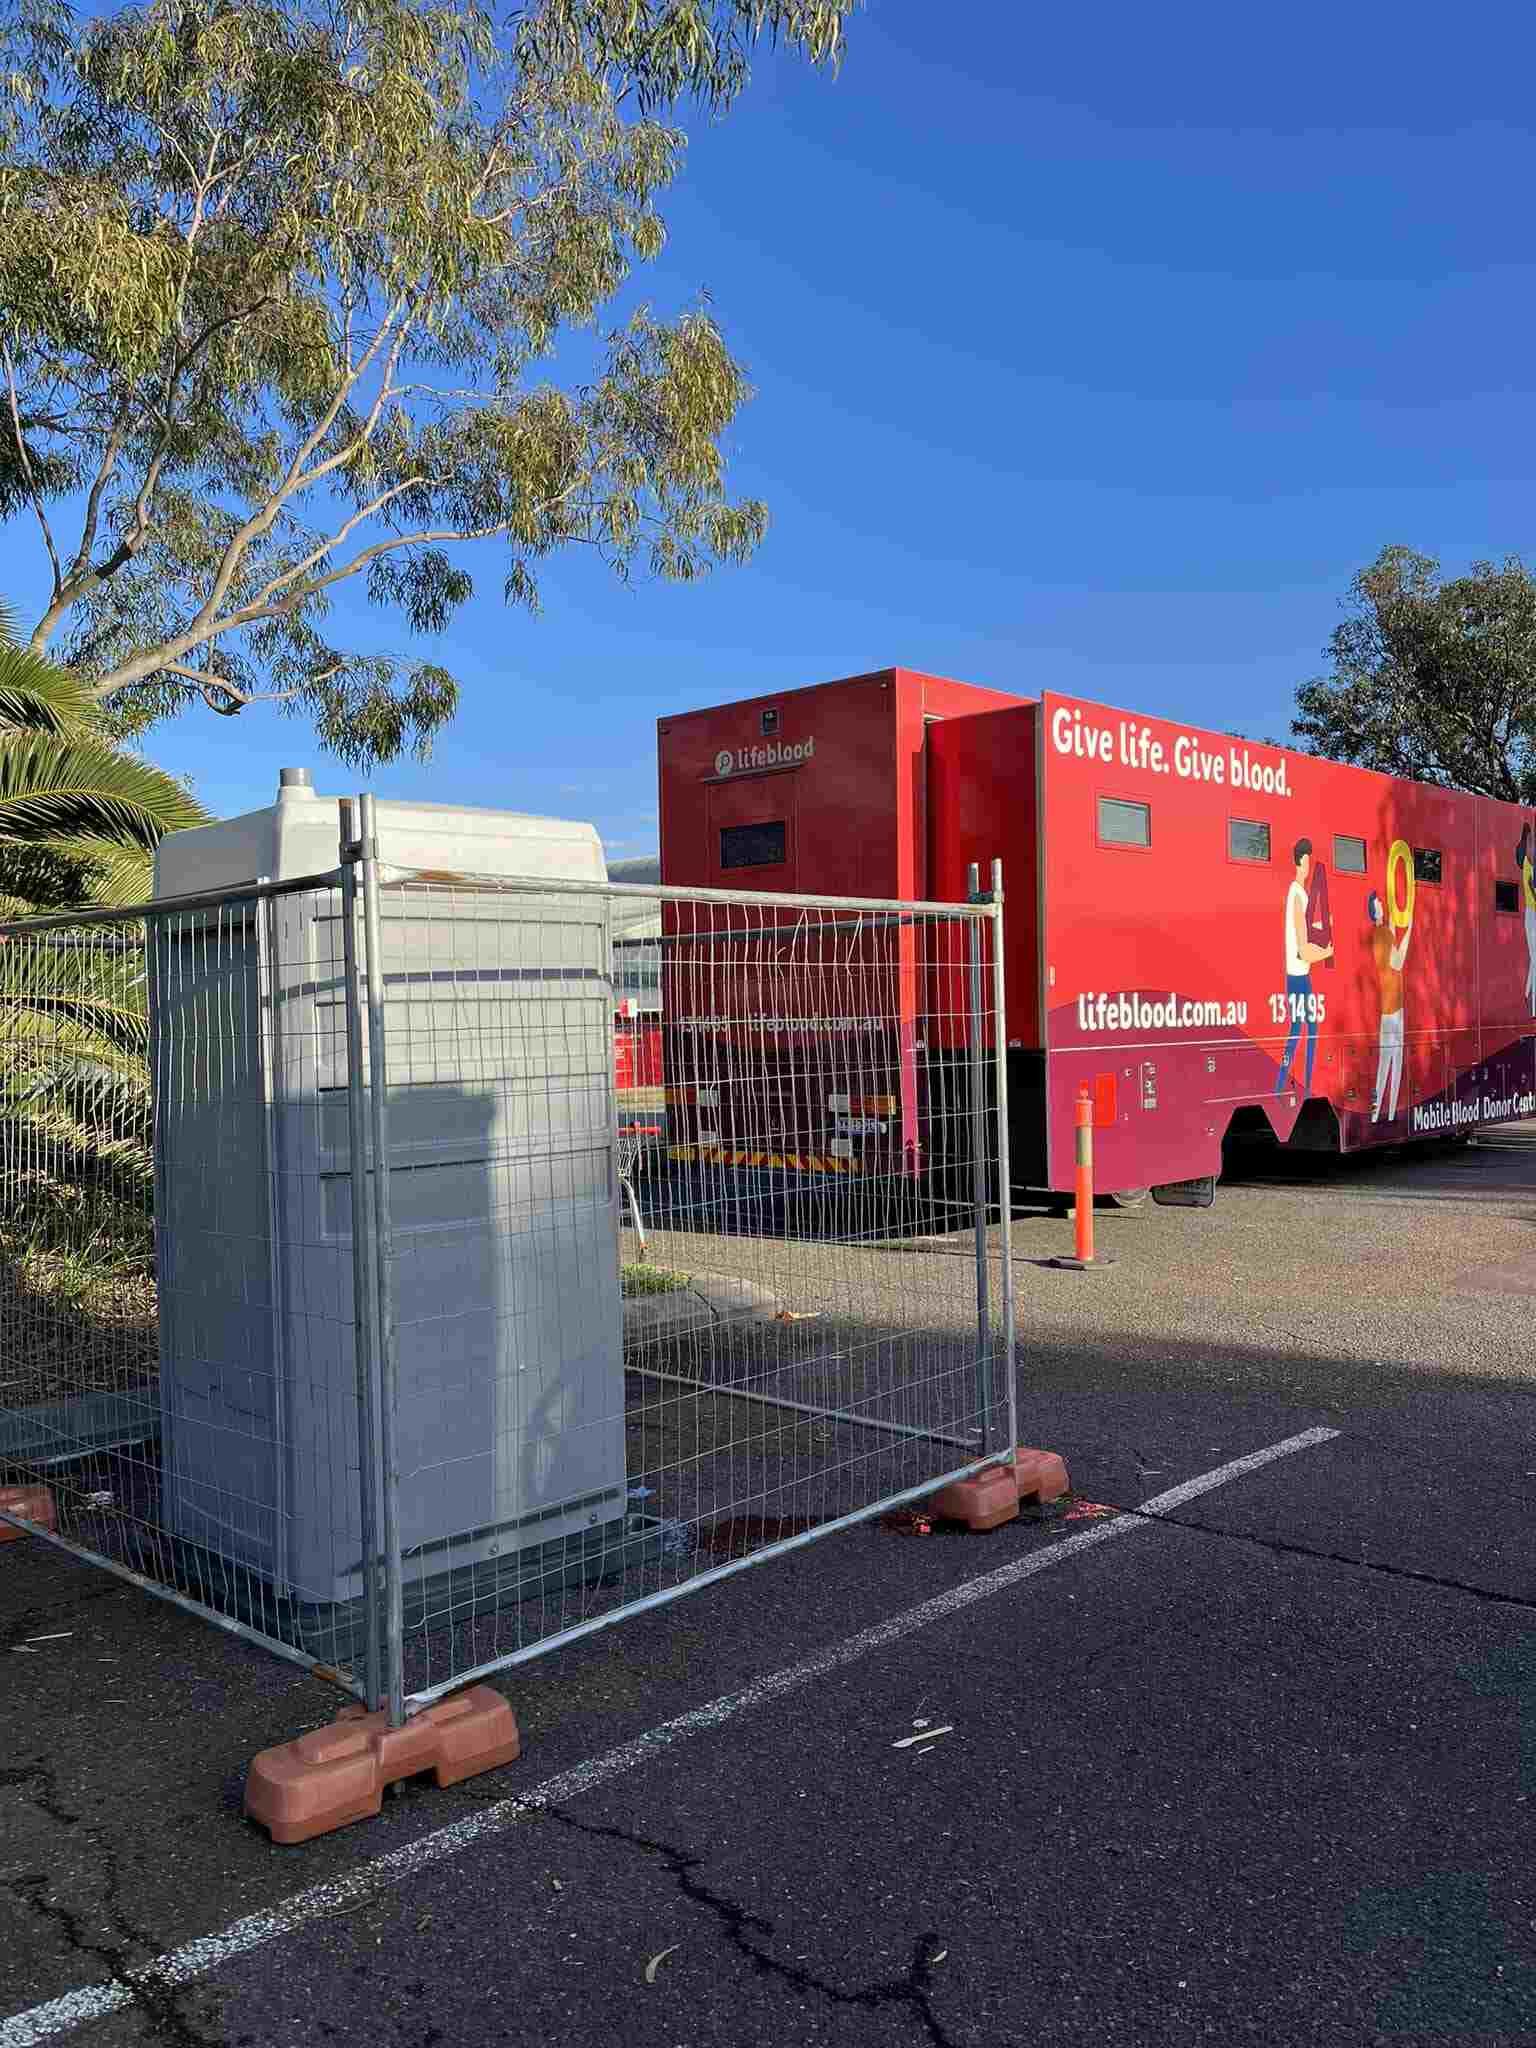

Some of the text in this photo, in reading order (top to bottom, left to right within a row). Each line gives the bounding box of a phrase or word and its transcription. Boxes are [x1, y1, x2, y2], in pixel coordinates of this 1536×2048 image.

[737, 736, 814, 769] lifeblood
[1052, 707, 1292, 797] Give life. Give blood.
[1078, 992, 1247, 1031] lifeblood.com.au
[1414, 1102, 1450, 1131] Mobile
[1452, 1098, 1480, 1124] Blood
[1484, 1096, 1512, 1119] Donor
